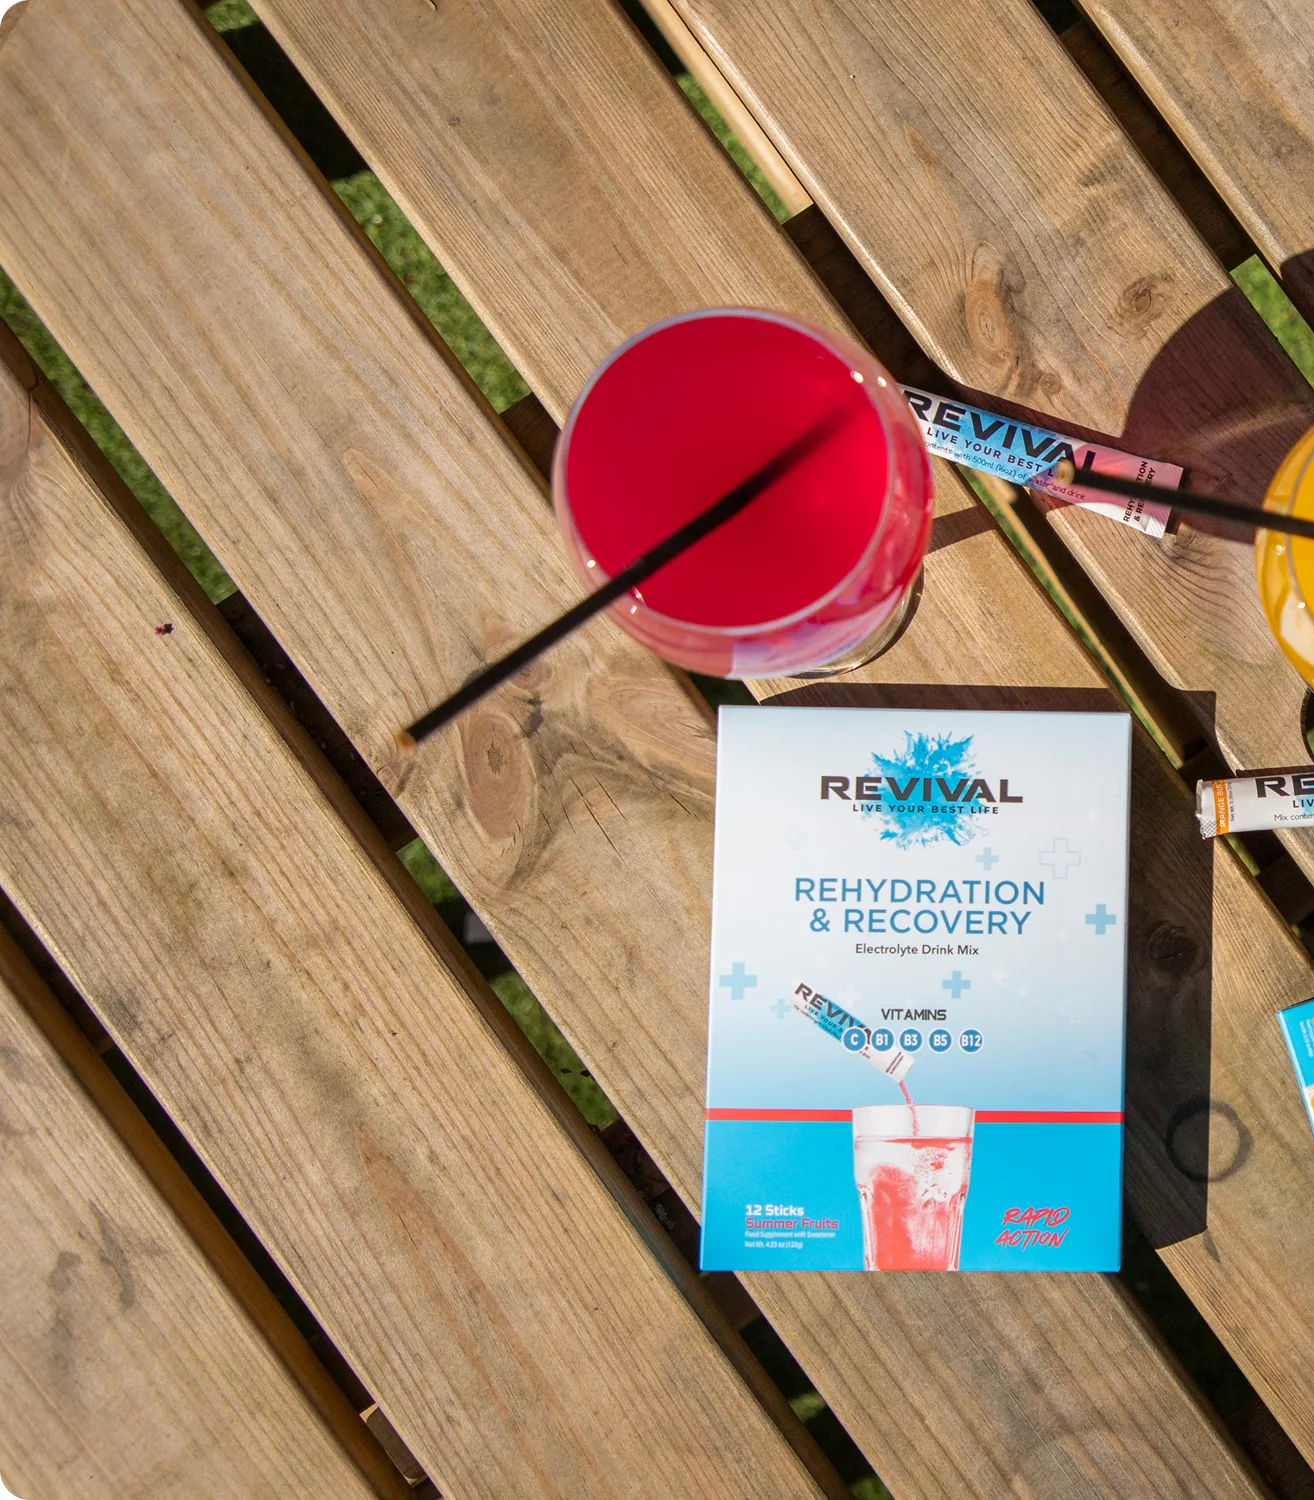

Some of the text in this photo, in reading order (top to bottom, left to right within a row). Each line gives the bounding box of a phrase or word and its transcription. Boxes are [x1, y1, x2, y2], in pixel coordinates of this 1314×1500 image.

[927, 427, 1042, 472] LIVE YOUR BEST
[923, 441, 952, 456] ontents
[954, 451, 971, 463] with
[972, 456, 995, 469] 500ml
[1018, 472, 1028, 481] of
[1052, 483, 1066, 494] and
[1067, 487, 1086, 500] drink
[1123, 460, 1148, 522] REHYTION
[1136, 467, 1156, 514] REERY
[820, 775, 1023, 804] REVIVAL
[852, 804, 999, 816] LIVE YOUR BEST LIFE
[1274, 813, 1288, 821] Mix
[795, 877, 1045, 906] REHYDRATION
[809, 908, 1031, 936] & RECOVERY
[855, 943, 979, 957] Electrolyte Drink Mix
[794, 982, 872, 1045] REVIVA
[881, 1008, 947, 1021] VITAMINS
[875, 1034, 889, 1046] B1
[903, 1034, 918, 1046] B3
[933, 1034, 948, 1047] B5
[961, 1034, 981, 1047] B12
[745, 1204, 804, 1216] 12 Sticks
[1002, 1205, 1070, 1228] RAPID
[745, 1217, 839, 1229] Summer Fruits
[994, 1227, 1070, 1251] ACTION
